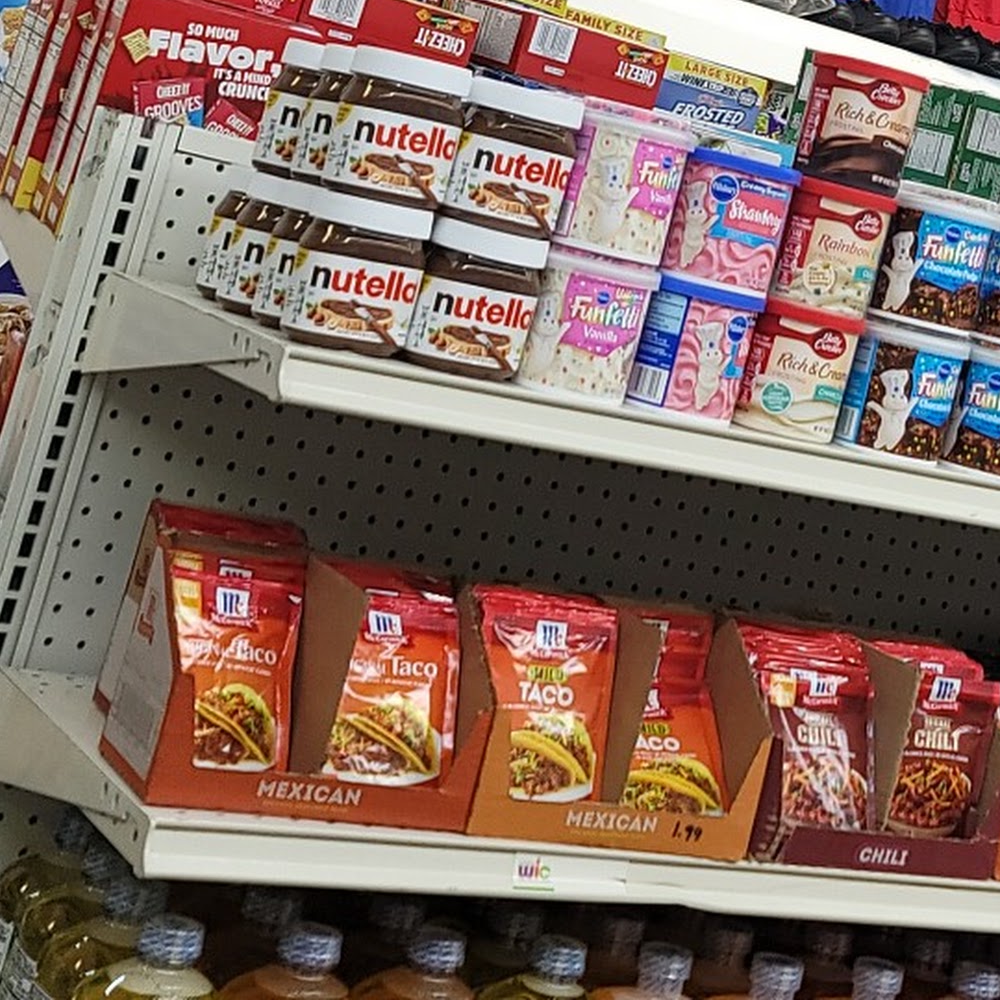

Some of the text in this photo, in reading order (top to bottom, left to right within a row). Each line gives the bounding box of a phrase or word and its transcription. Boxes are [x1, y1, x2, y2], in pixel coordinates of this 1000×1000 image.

[187, 23, 239, 42] SO MUCH
[565, 8, 644, 42] FAMILY SIZE
[148, 28, 282, 78] Flavor,
[684, 61, 748, 87] LARGE SIZE
[218, 81, 269, 100] CRUNC
[672, 102, 746, 126] FROSTED
[835, 101, 865, 121] Rich
[865, 111, 876, 125] &
[922, 234, 987, 269] Funfetti
[570, 294, 641, 330] Funfetti
[777, 352, 808, 372] Rich
[808, 361, 819, 375] &
[392, 655, 438, 678] Taco
[519, 681, 574, 707] TACO
[635, 734, 680, 752] ACO
[258, 779, 362, 806] MEXICAN
[566, 808, 657, 833] MEXICAN
[672, 820, 702, 842] 1.99
[518, 856, 551, 880] wic
[859, 846, 908, 866] CHILI
